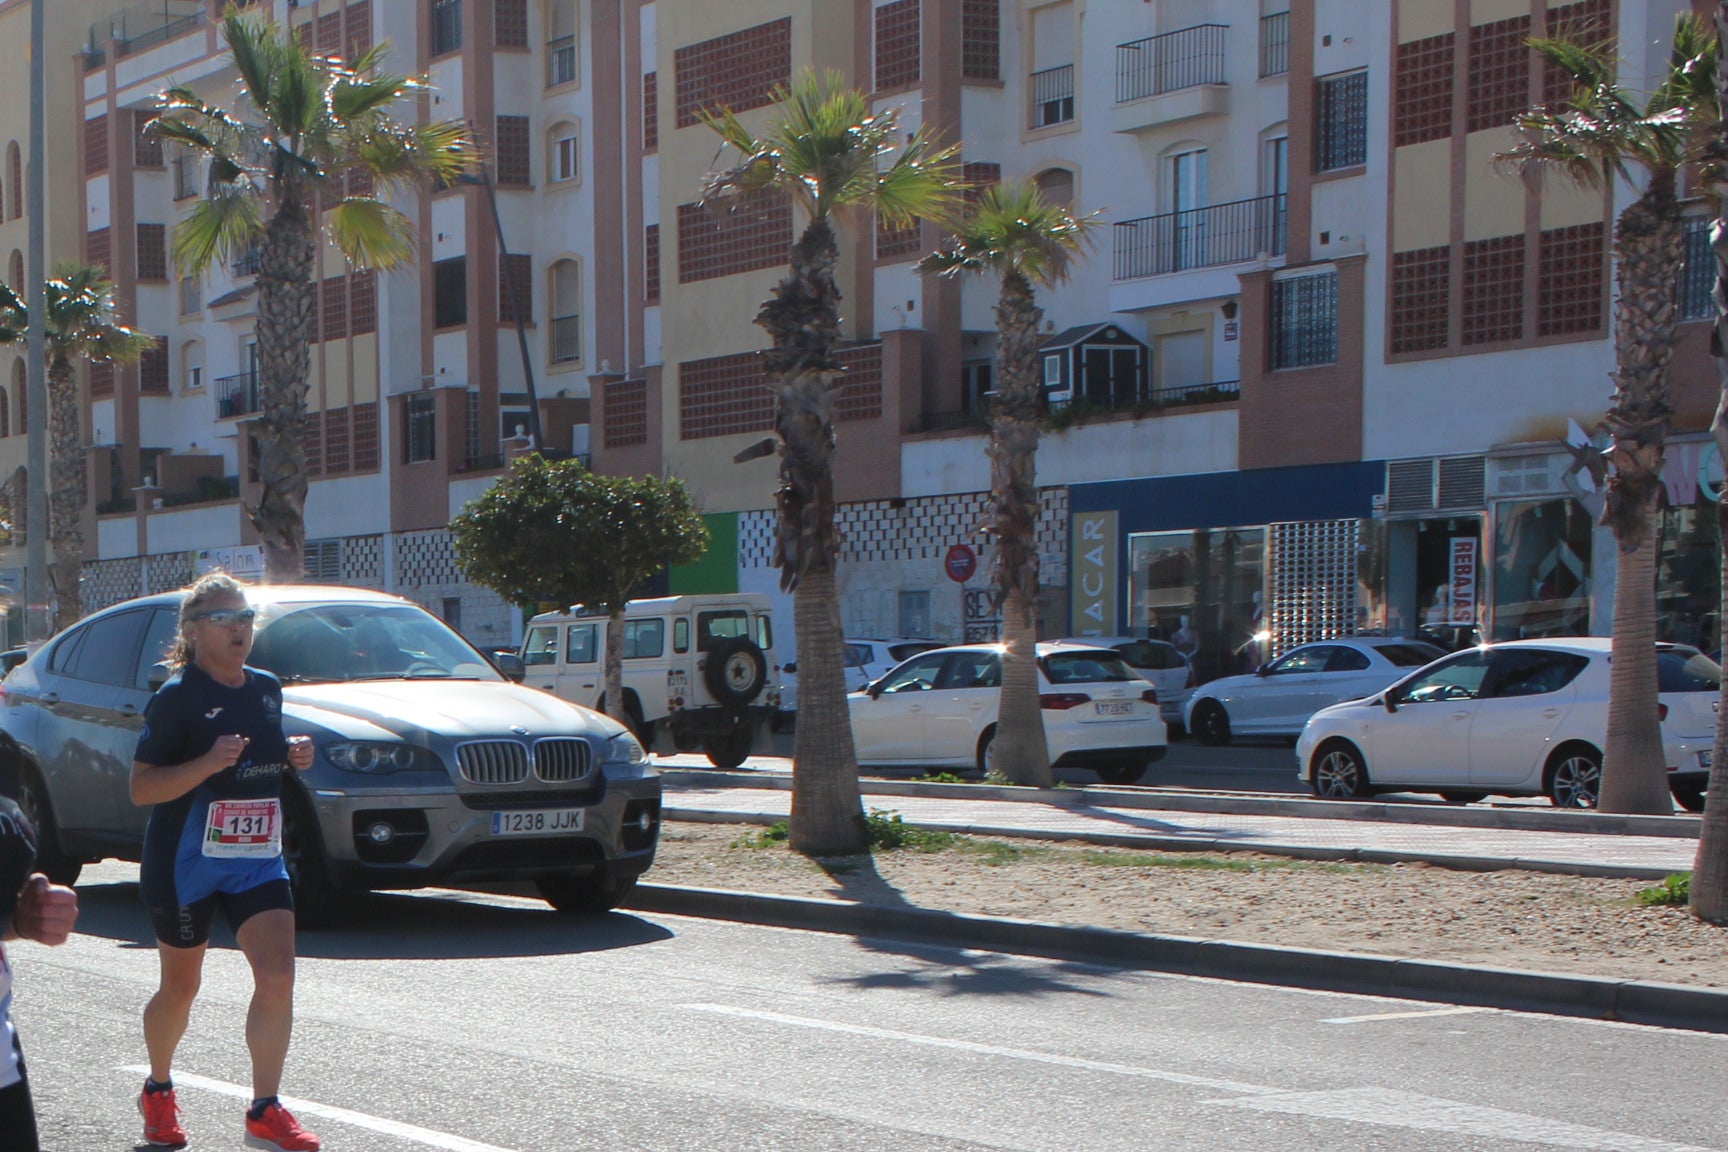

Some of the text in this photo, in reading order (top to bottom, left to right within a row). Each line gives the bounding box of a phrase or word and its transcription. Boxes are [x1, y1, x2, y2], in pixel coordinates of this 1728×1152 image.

[1454, 541, 1473, 622] REBAJAS
[243, 764, 281, 778] DEHARO
[230, 817, 263, 834] 131
[504, 811, 580, 831] 1238 JJK
